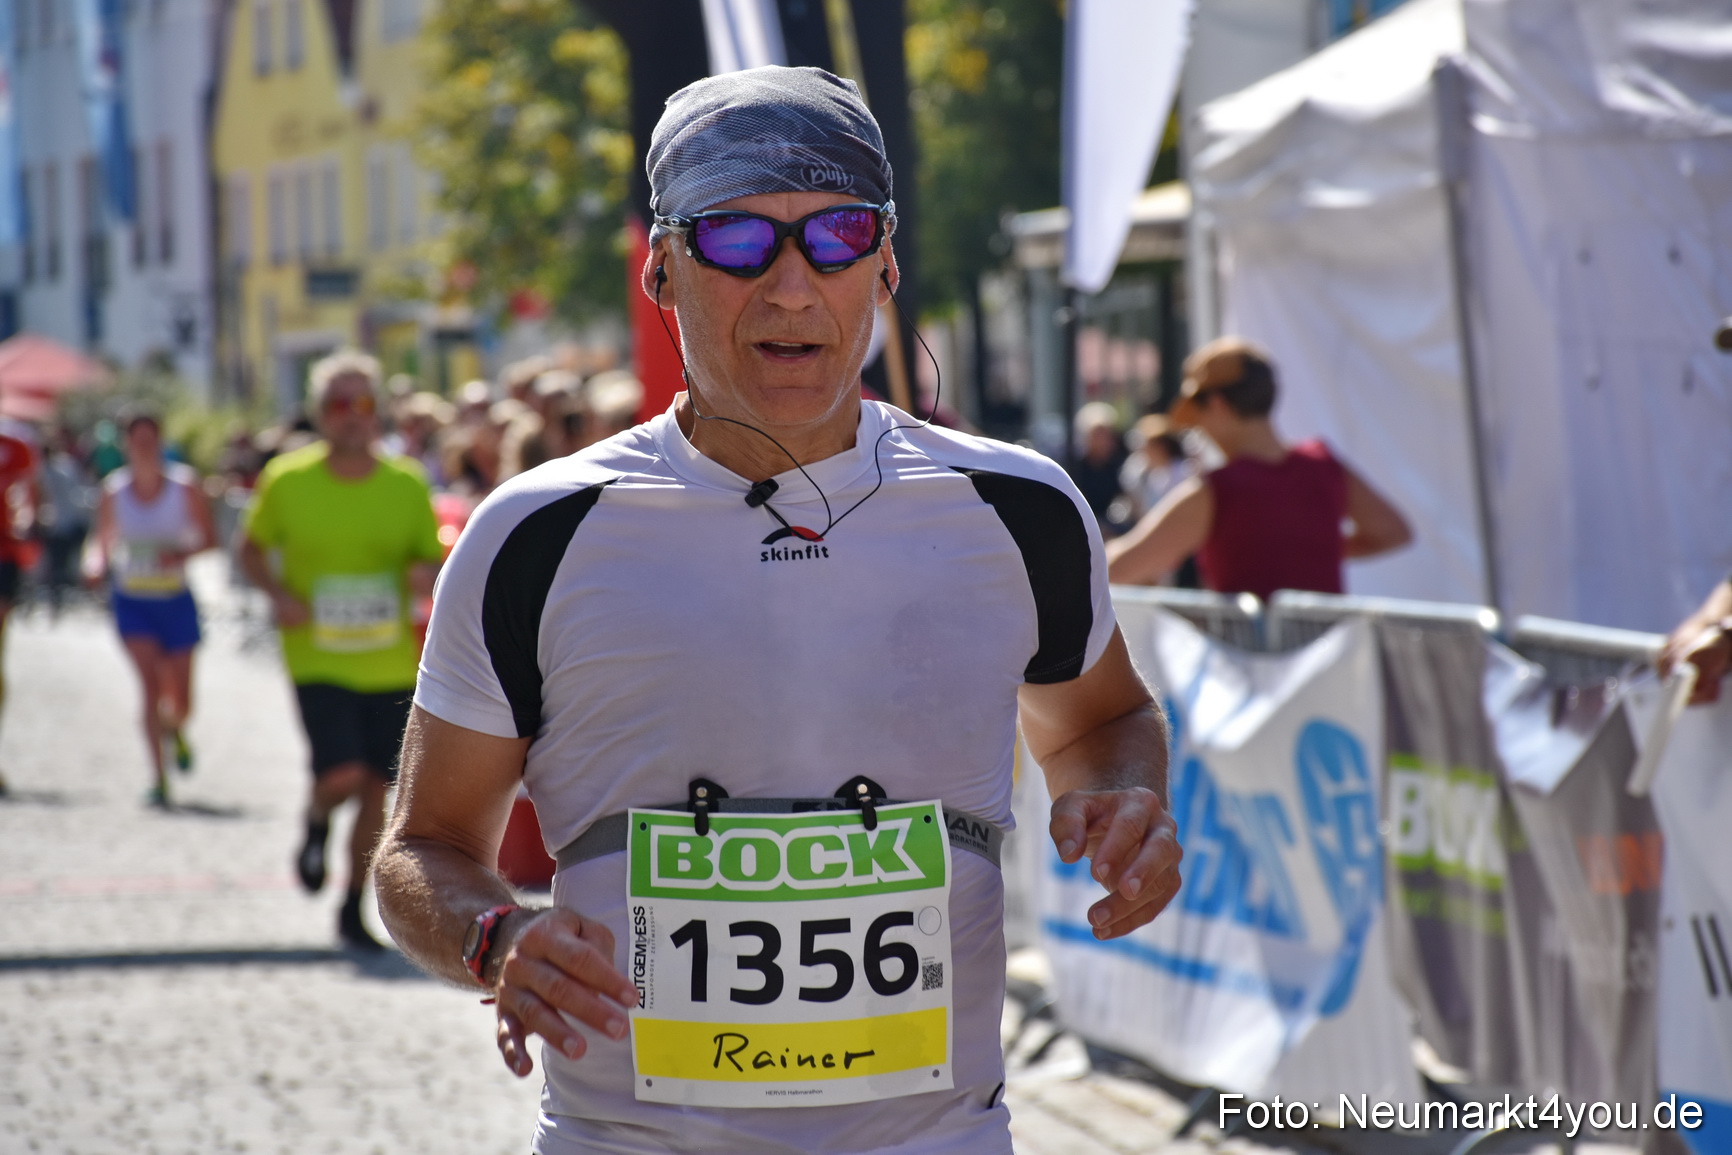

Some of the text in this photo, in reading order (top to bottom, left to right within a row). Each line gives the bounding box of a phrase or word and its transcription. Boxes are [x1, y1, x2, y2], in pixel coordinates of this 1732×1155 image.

[760, 545, 829, 562] skinfit
[654, 823, 916, 886] BOCK
[669, 911, 920, 1006] 1356
[713, 1032, 876, 1073] Rainer
